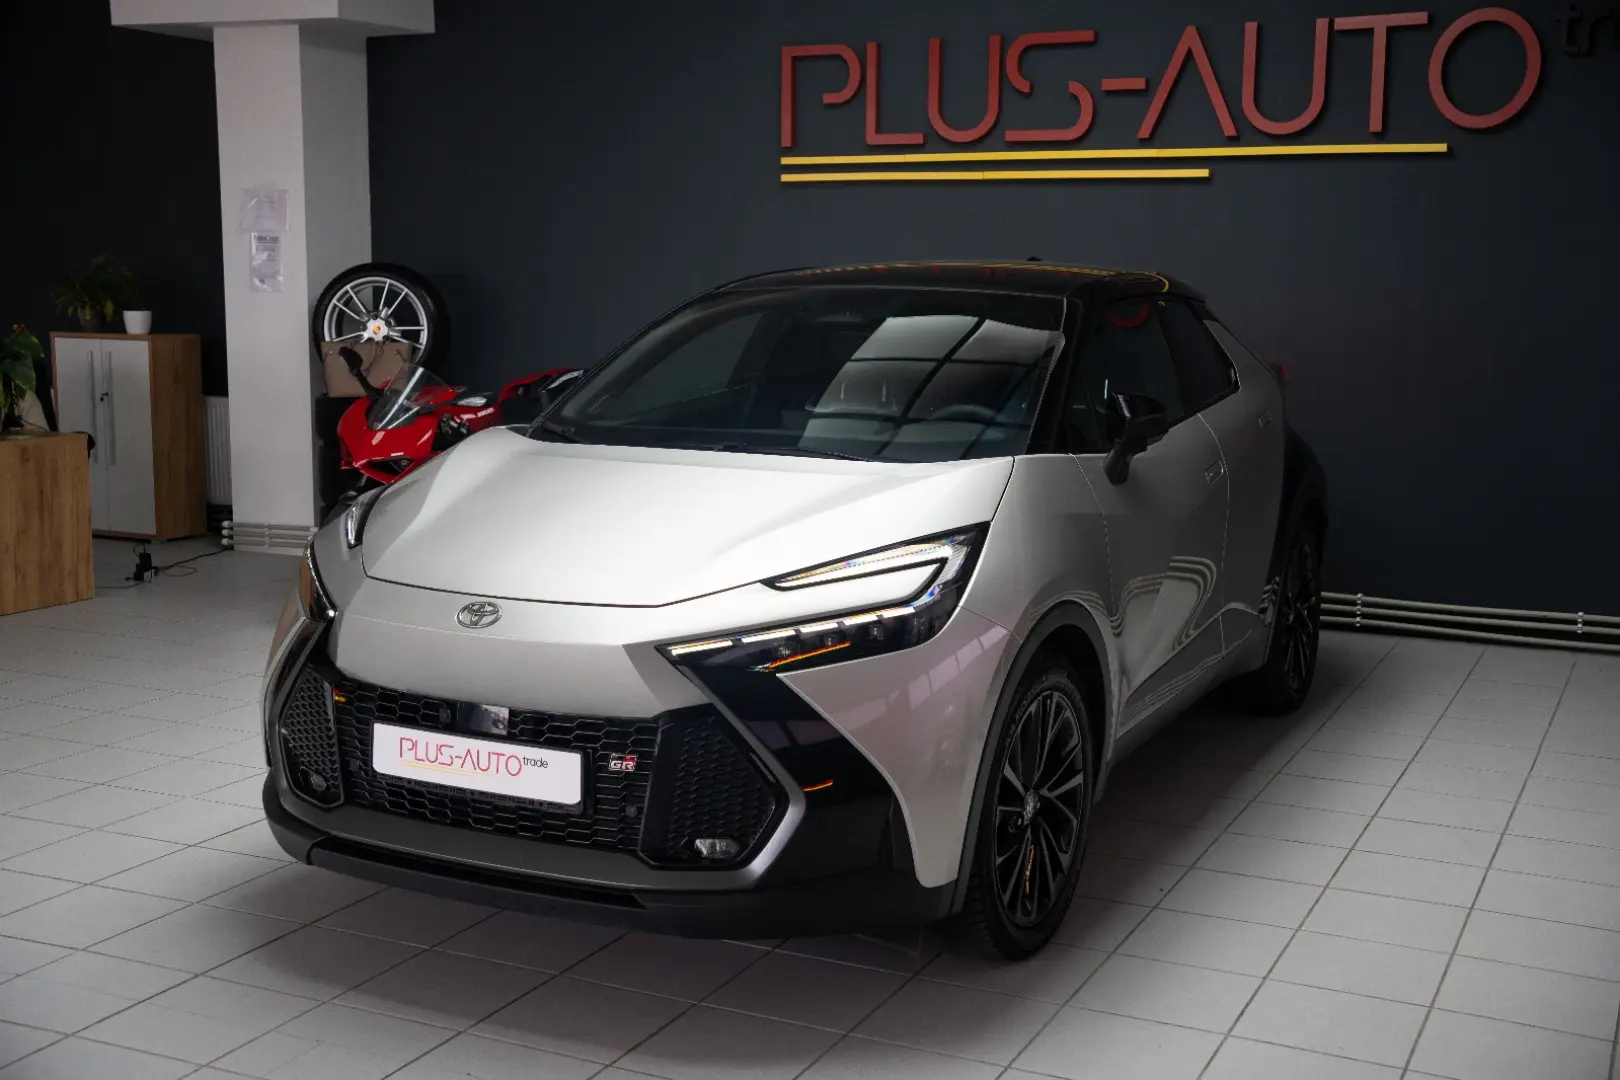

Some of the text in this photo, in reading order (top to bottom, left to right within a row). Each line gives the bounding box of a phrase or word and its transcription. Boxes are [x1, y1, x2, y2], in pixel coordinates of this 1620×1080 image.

[780, 4, 1620, 148] PLUS-AUTO tr
[400, 737, 549, 777] PLUS-AUTO trade
[610, 759, 635, 771] GR
